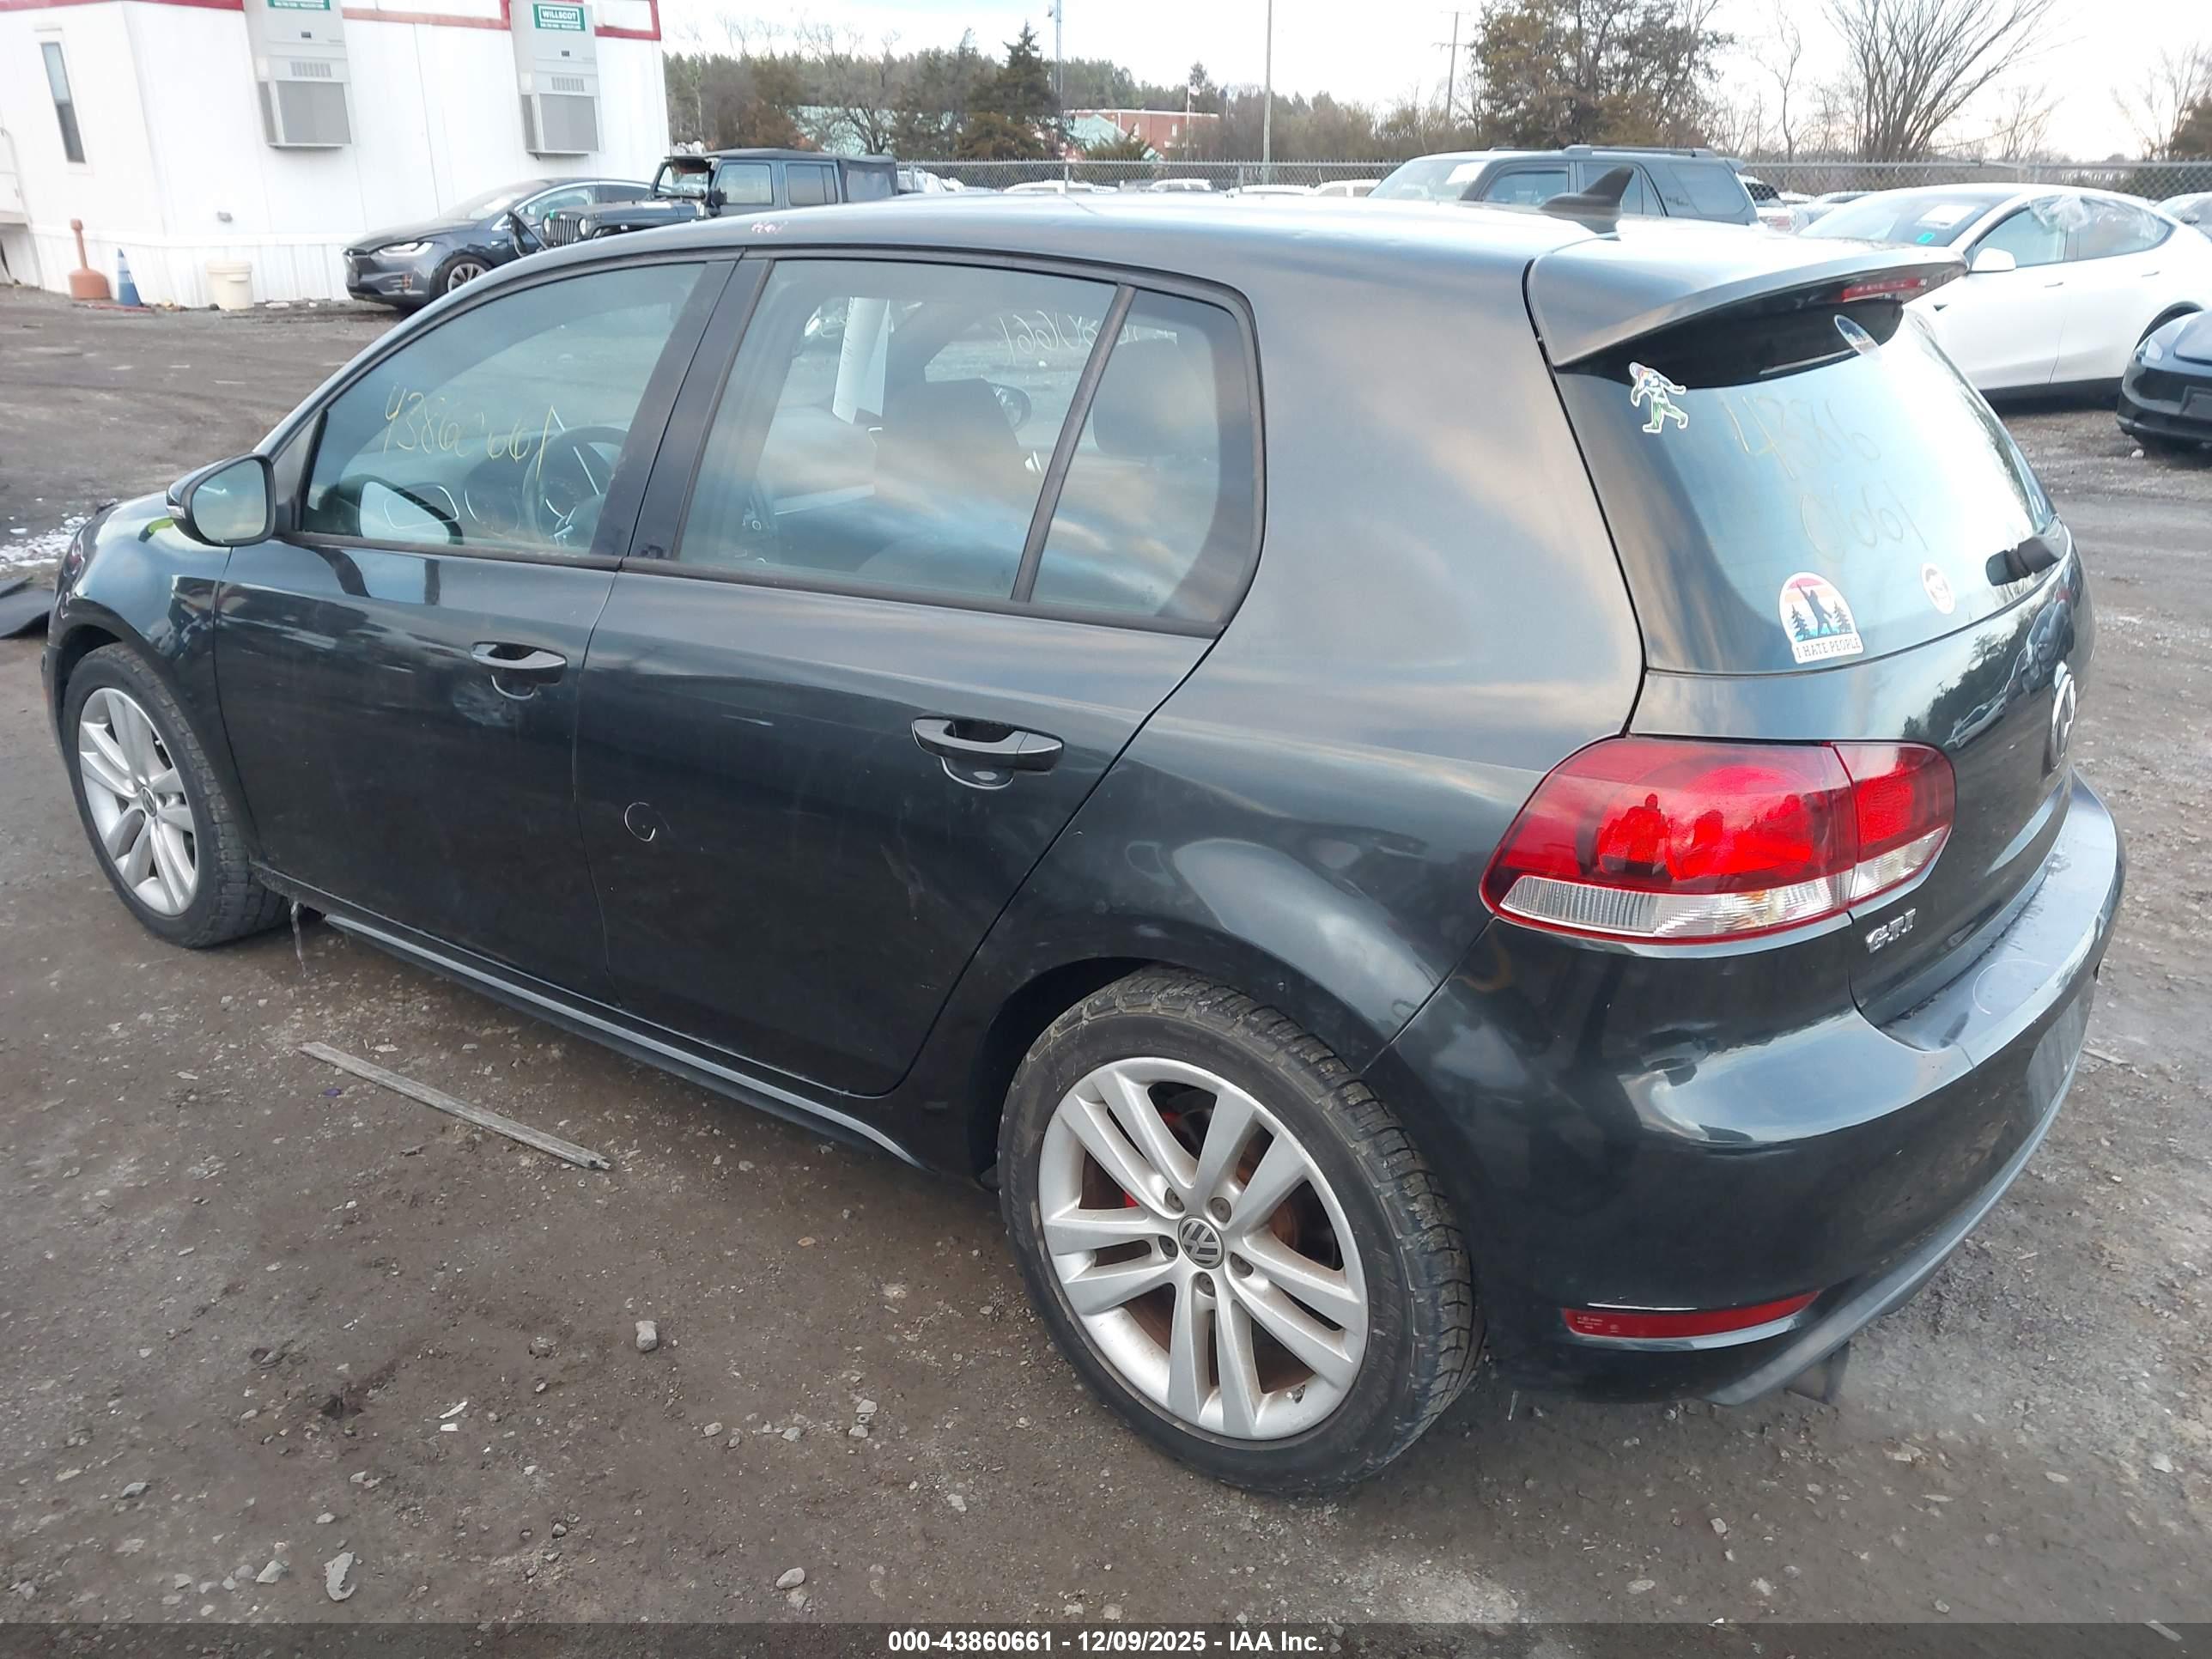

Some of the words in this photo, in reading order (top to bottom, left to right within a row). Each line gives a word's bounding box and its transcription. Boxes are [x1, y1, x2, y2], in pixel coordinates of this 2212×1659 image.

[542, 9, 576, 21] WILLSCOT
[1802, 643, 1828, 656] HATE
[1865, 908, 1917, 953] GTI
